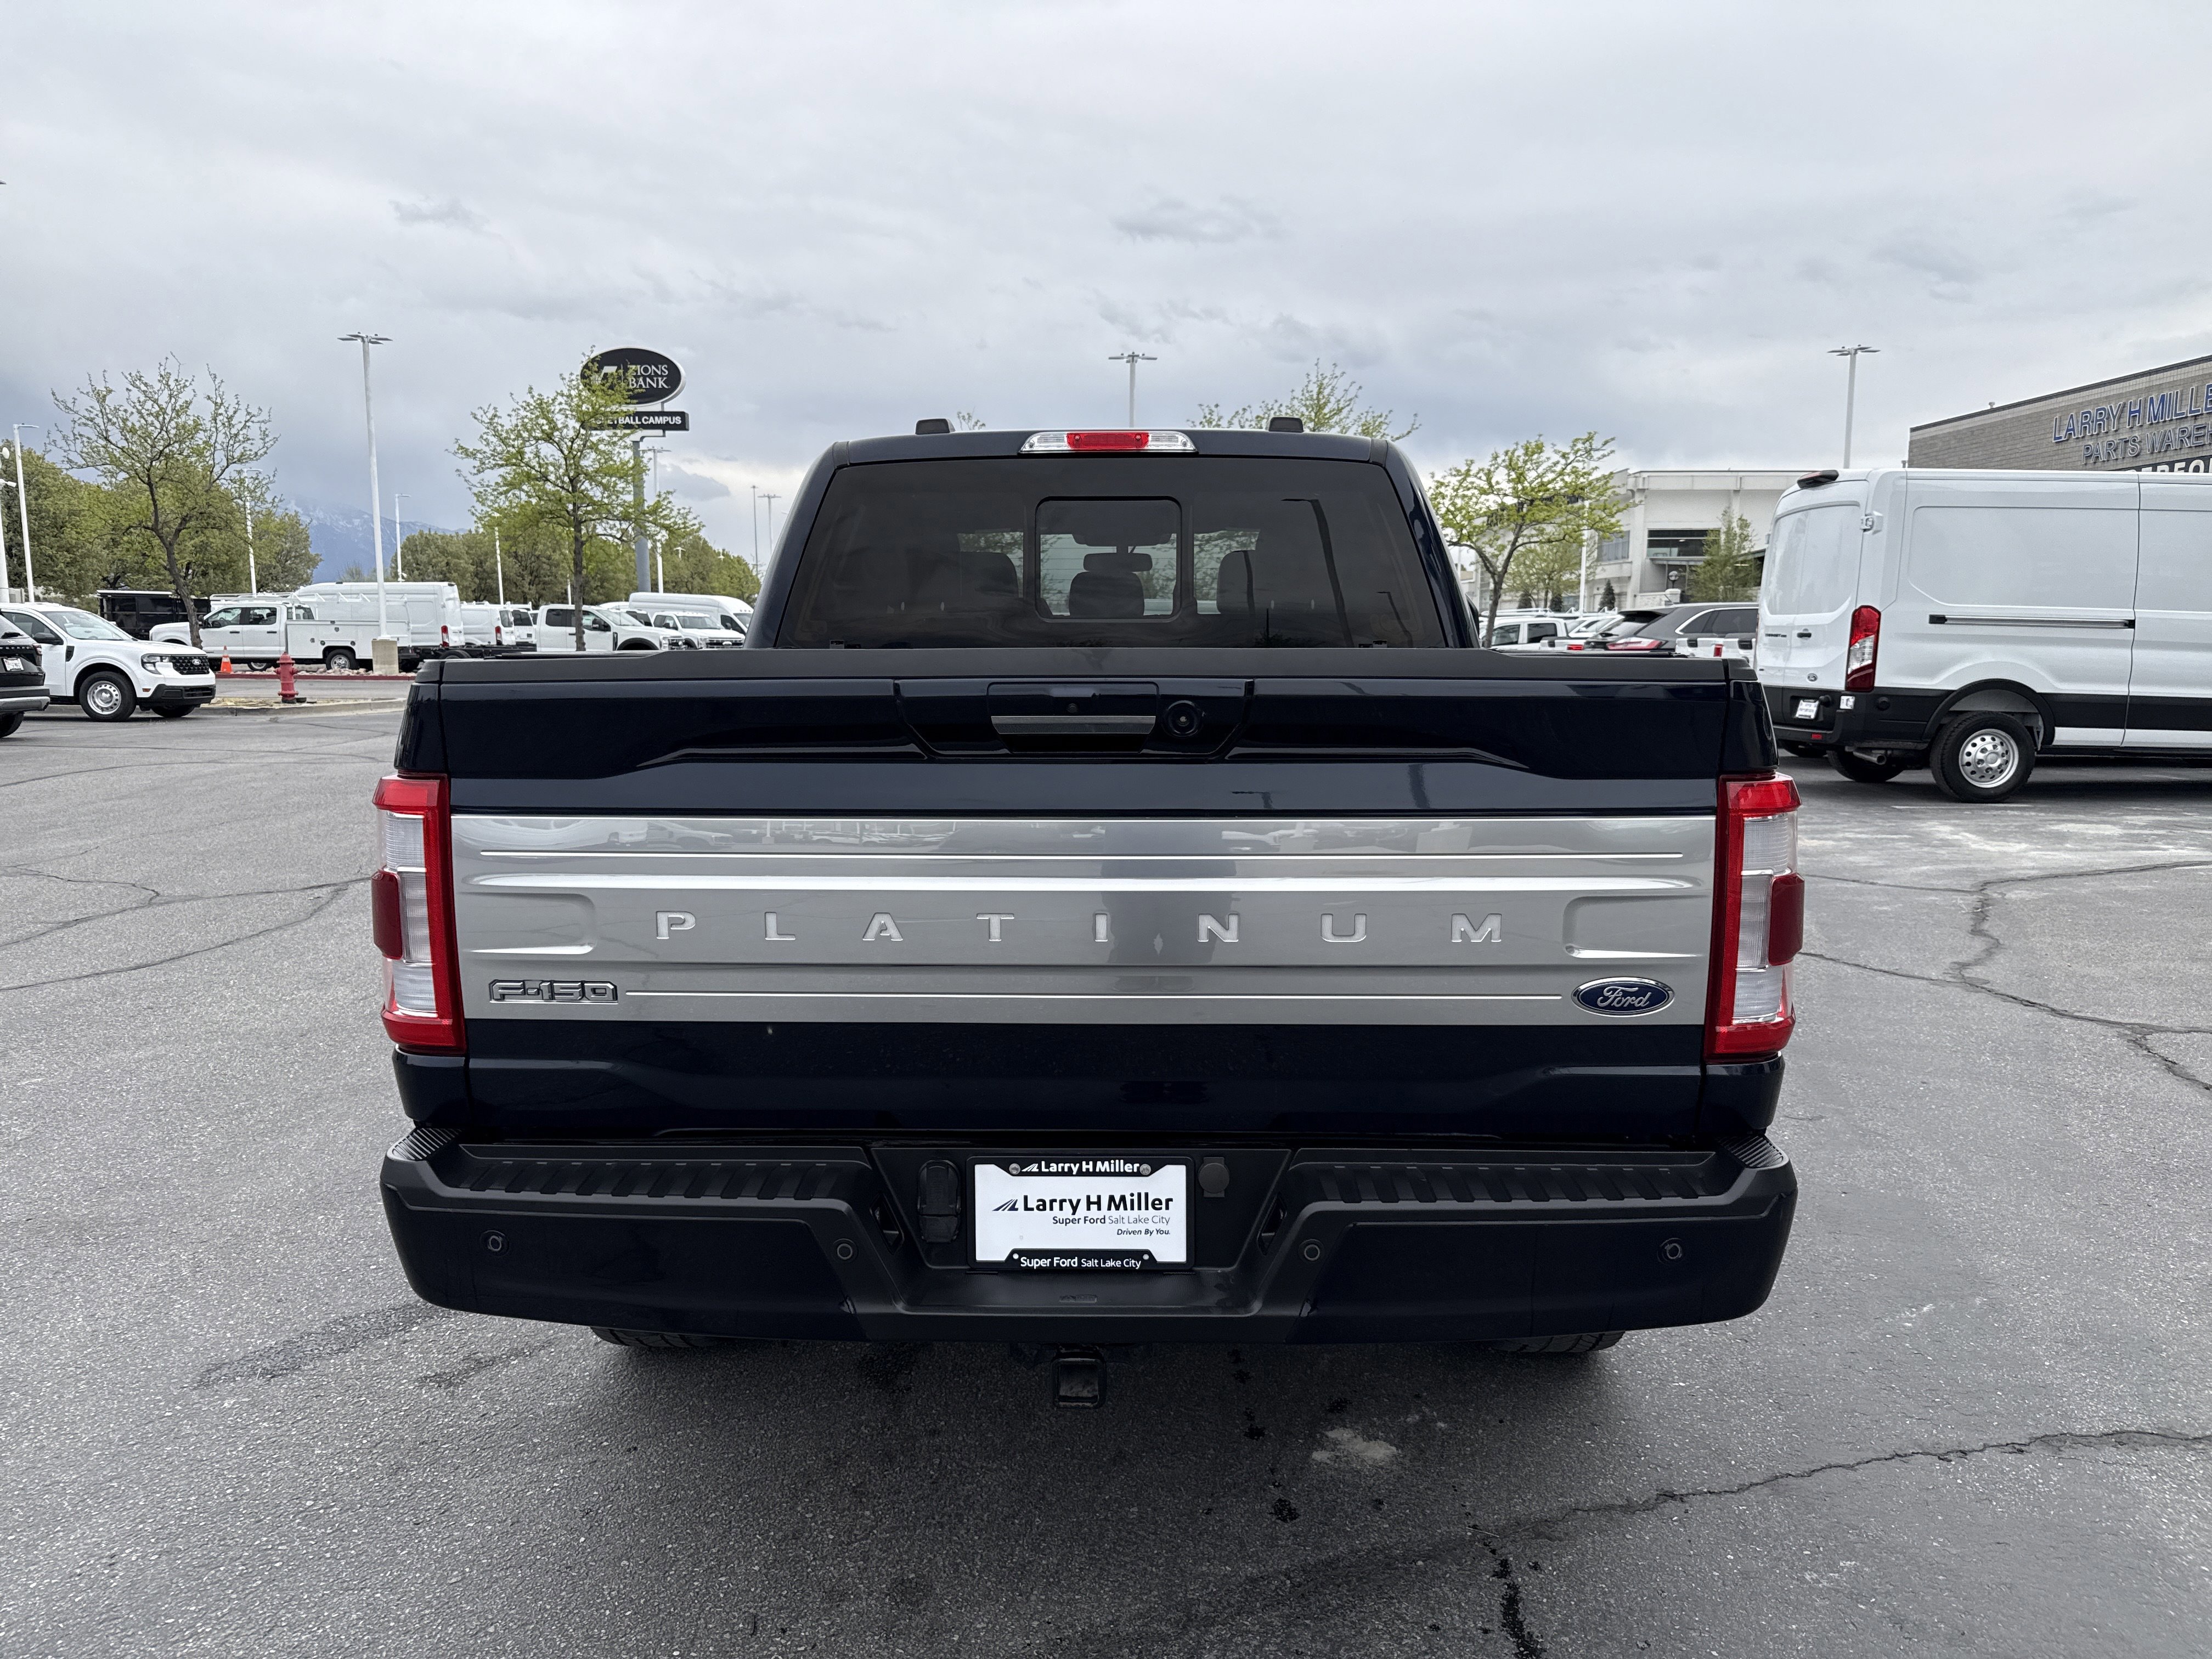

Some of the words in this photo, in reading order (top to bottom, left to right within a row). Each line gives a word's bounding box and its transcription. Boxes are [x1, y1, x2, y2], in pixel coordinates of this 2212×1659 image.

[629, 377, 669, 389] BANK
[642, 416, 682, 425] CAMPUS
[2053, 402, 2124, 443] LARRY
[2126, 398, 2143, 428] H
[2082, 435, 2140, 464] PARTS
[656, 911, 1502, 943] PLATINUM
[488, 979, 618, 1005] F-150
[1597, 986, 1652, 1007] Ford
[1041, 1161, 1080, 1175] Larry
[1082, 1161, 1093, 1172] H
[1096, 1160, 1140, 1172] Miller
[1023, 1194, 1082, 1216] Larry
[1086, 1194, 1102, 1211] H
[1107, 1192, 1173, 1211] Miller
[1052, 1216, 1082, 1227] Super
[1084, 1215, 1106, 1224] Ford
[1108, 1215, 1125, 1224] Salt
[1127, 1215, 1149, 1224] Lake
[1152, 1215, 1171, 1226] City
[1144, 1228, 1154, 1237] By
[1020, 1257, 1052, 1269] Super
[1053, 1256, 1078, 1267] Ford
[1081, 1259, 1098, 1267] Salt
[1101, 1259, 1121, 1267] Lake
[1123, 1258, 1142, 1270] City
